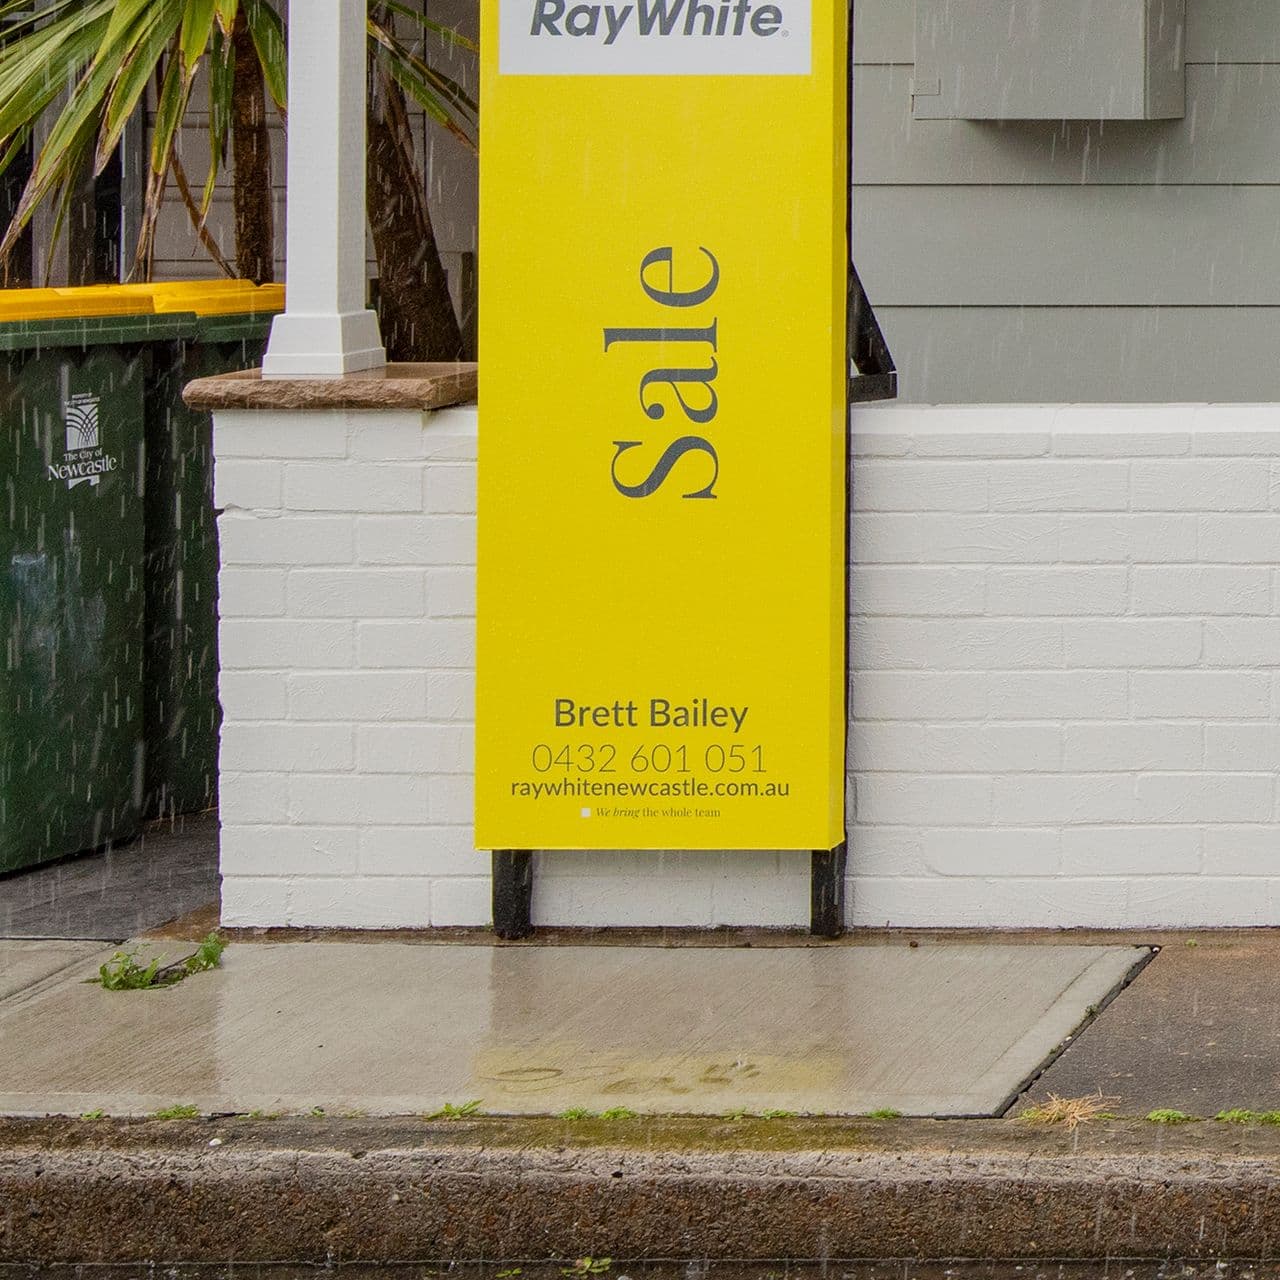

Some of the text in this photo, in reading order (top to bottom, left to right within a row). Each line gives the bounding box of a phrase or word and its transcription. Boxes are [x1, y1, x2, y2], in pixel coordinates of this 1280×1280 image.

[603, 246, 720, 499] Sale
[47, 454, 118, 481] Newcastle
[63, 447, 103, 462] The City of
[553, 698, 749, 733] Brett Bailey
[531, 743, 768, 773] 0432 601 051
[510, 777, 790, 800] raywhitenewcastle.com.au
[596, 806, 721, 819] We bring the whole team
